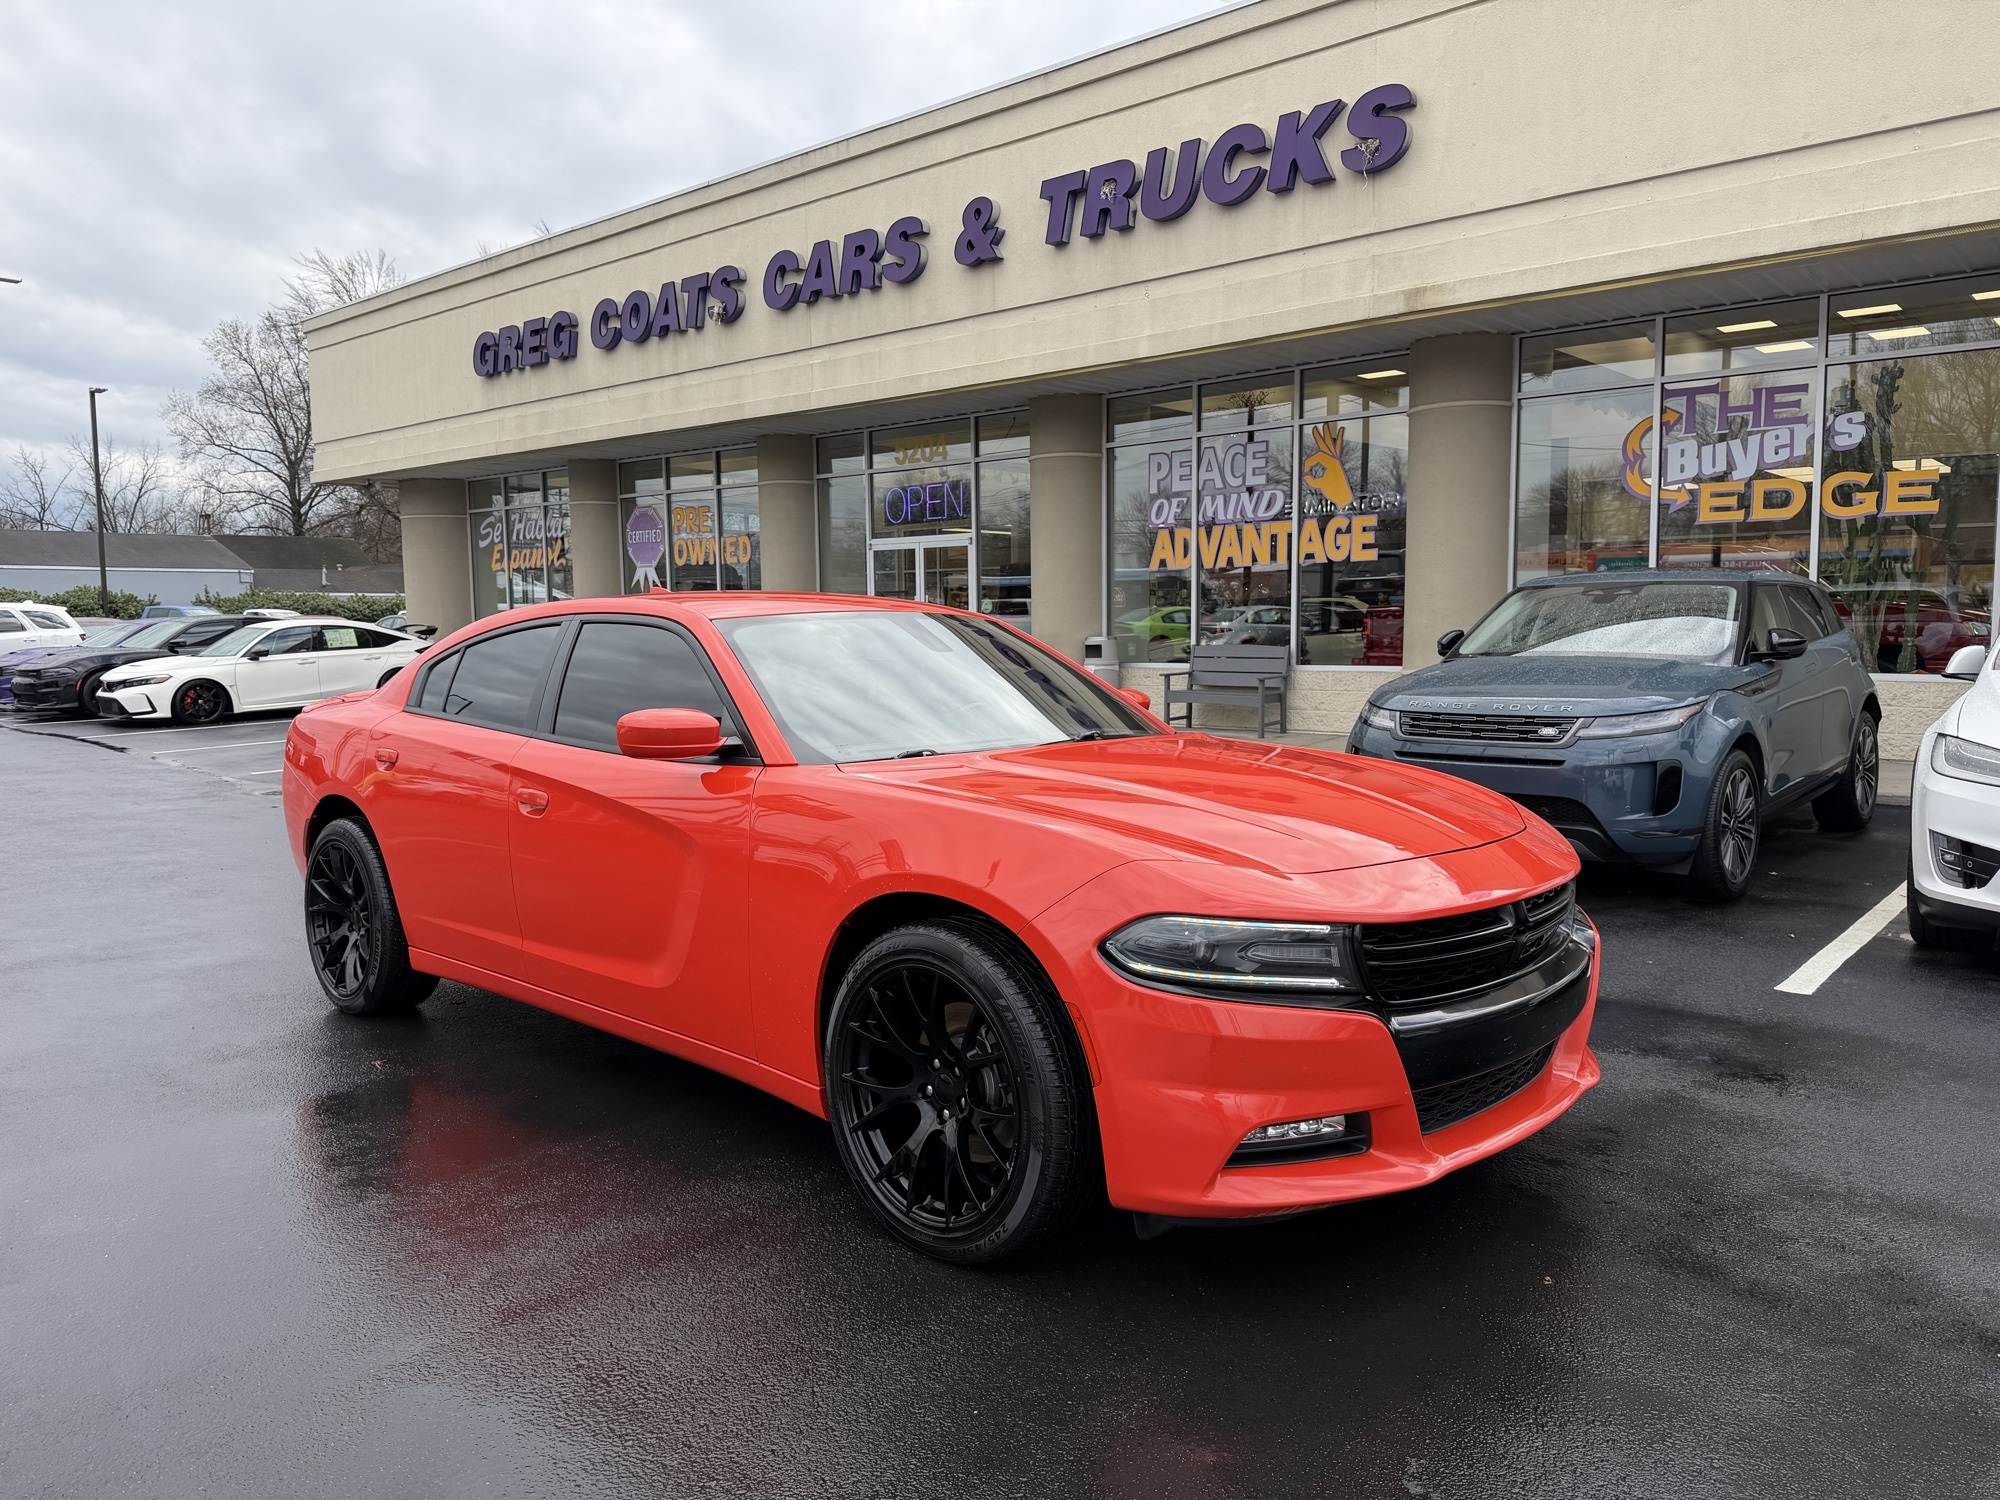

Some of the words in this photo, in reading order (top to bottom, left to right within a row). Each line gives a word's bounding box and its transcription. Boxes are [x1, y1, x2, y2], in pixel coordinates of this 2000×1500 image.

[472, 310, 578, 378] GREG
[590, 265, 747, 350] COATS
[762, 216, 930, 311] CARS
[953, 196, 1005, 268] &
[1039, 83, 1418, 247] TRUCKS
[1664, 381, 1809, 438] THE
[894, 432, 947, 465] 5204
[1148, 440, 1269, 494] PEACE
[1662, 411, 1868, 486] Buyer's
[885, 481, 963, 524] OPEN
[1149, 496, 1188, 528] OF
[1198, 488, 1286, 525] MIND
[1694, 468, 1941, 525] EDGE
[478, 515, 503, 548] Se
[511, 509, 567, 541] Habla
[628, 529, 662, 544] CERTIFIED
[672, 505, 717, 535] PRE-
[674, 535, 752, 567] OWNED
[1148, 514, 1379, 571] ADVANTAGE
[1408, 700, 1478, 710] RANGE
[1493, 703, 1574, 713] ROVER
